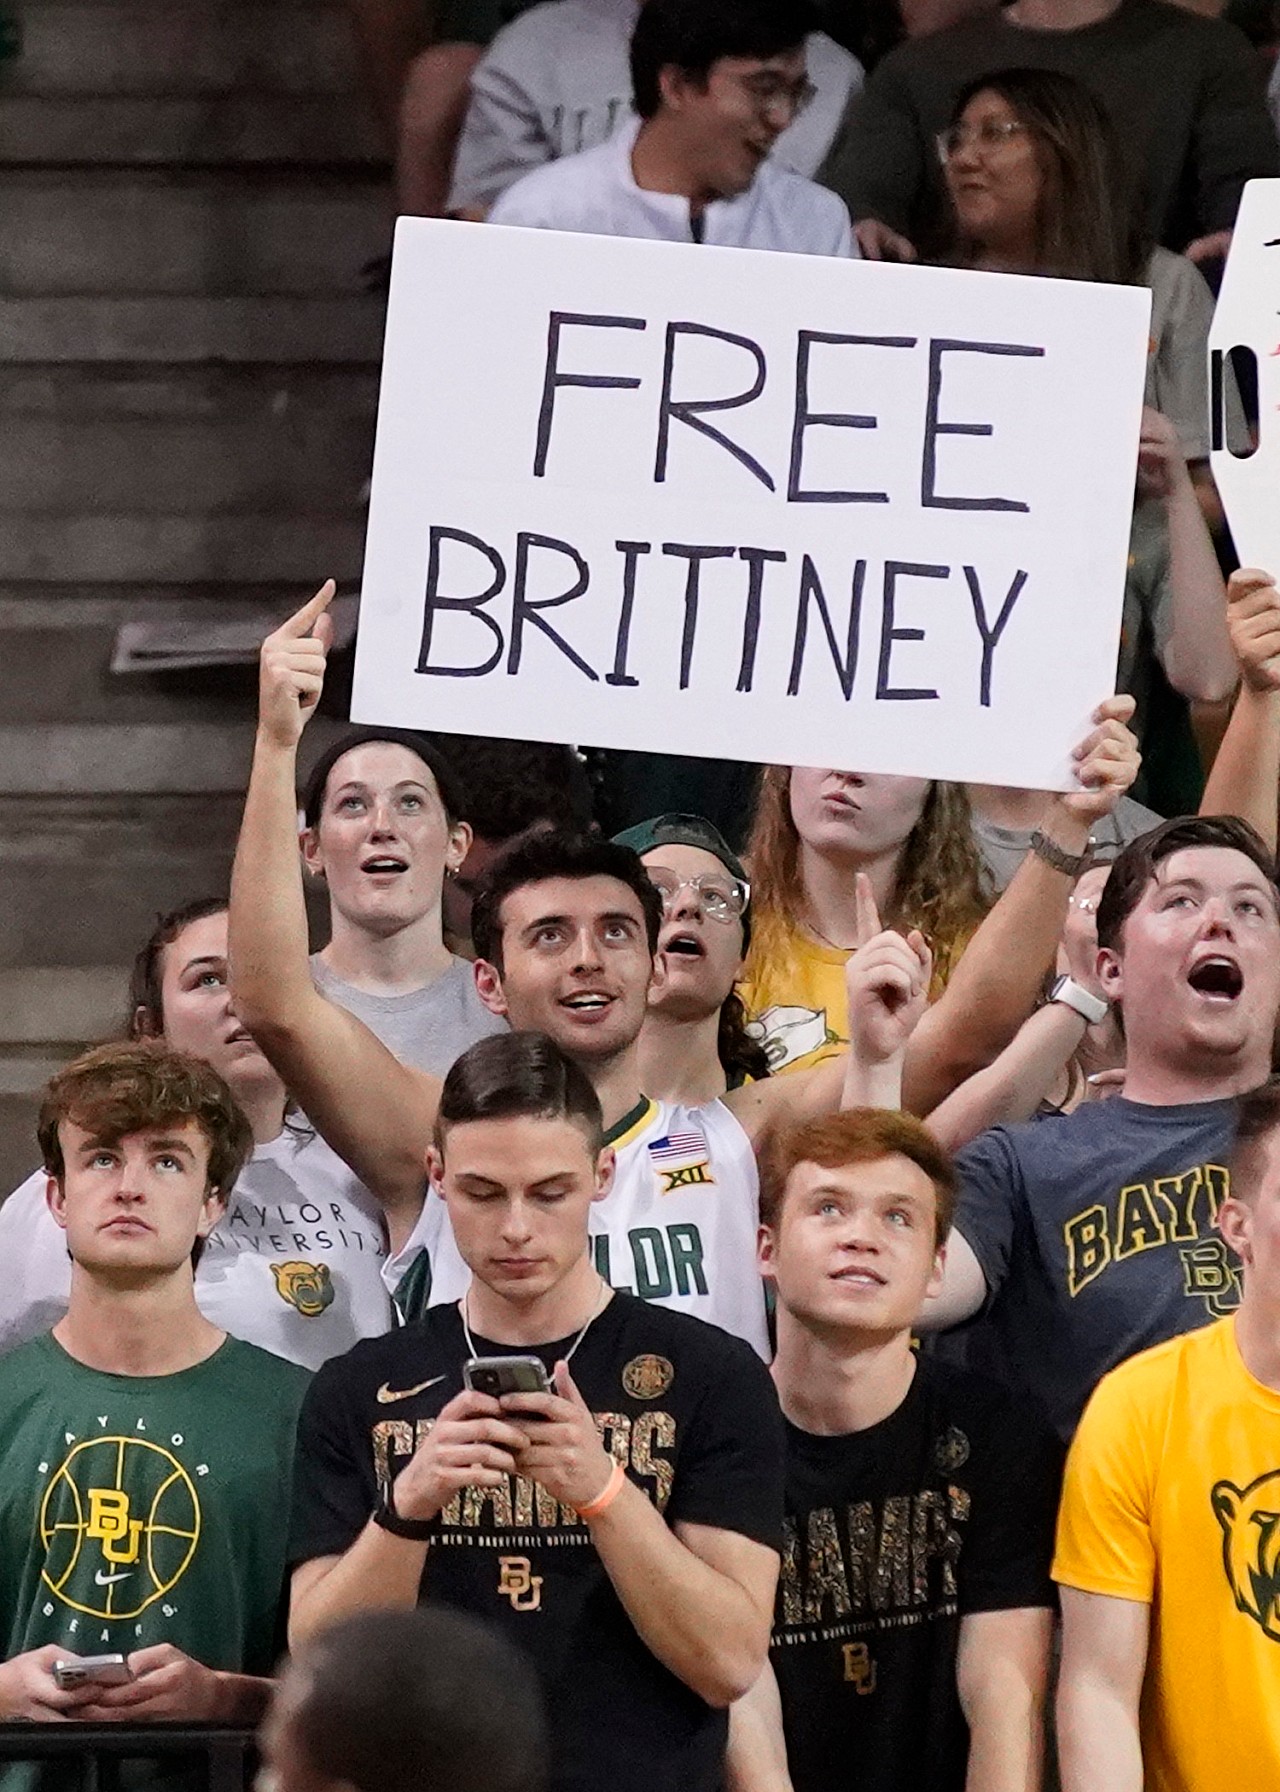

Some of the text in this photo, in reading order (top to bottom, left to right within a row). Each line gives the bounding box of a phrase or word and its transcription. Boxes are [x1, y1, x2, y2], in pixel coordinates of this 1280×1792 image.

[533, 310, 1046, 513] FREE
[414, 525, 1029, 708] BRITTNEY
[659, 1161, 715, 1194] XII
[207, 1228, 384, 1257] NIVERSIT
[229, 1202, 346, 1228] AYLOR
[589, 1223, 709, 1299] LOR
[38, 1415, 210, 1477] BAYLOR
[86, 1487, 144, 1564] BU
[497, 1555, 544, 1612] BU
